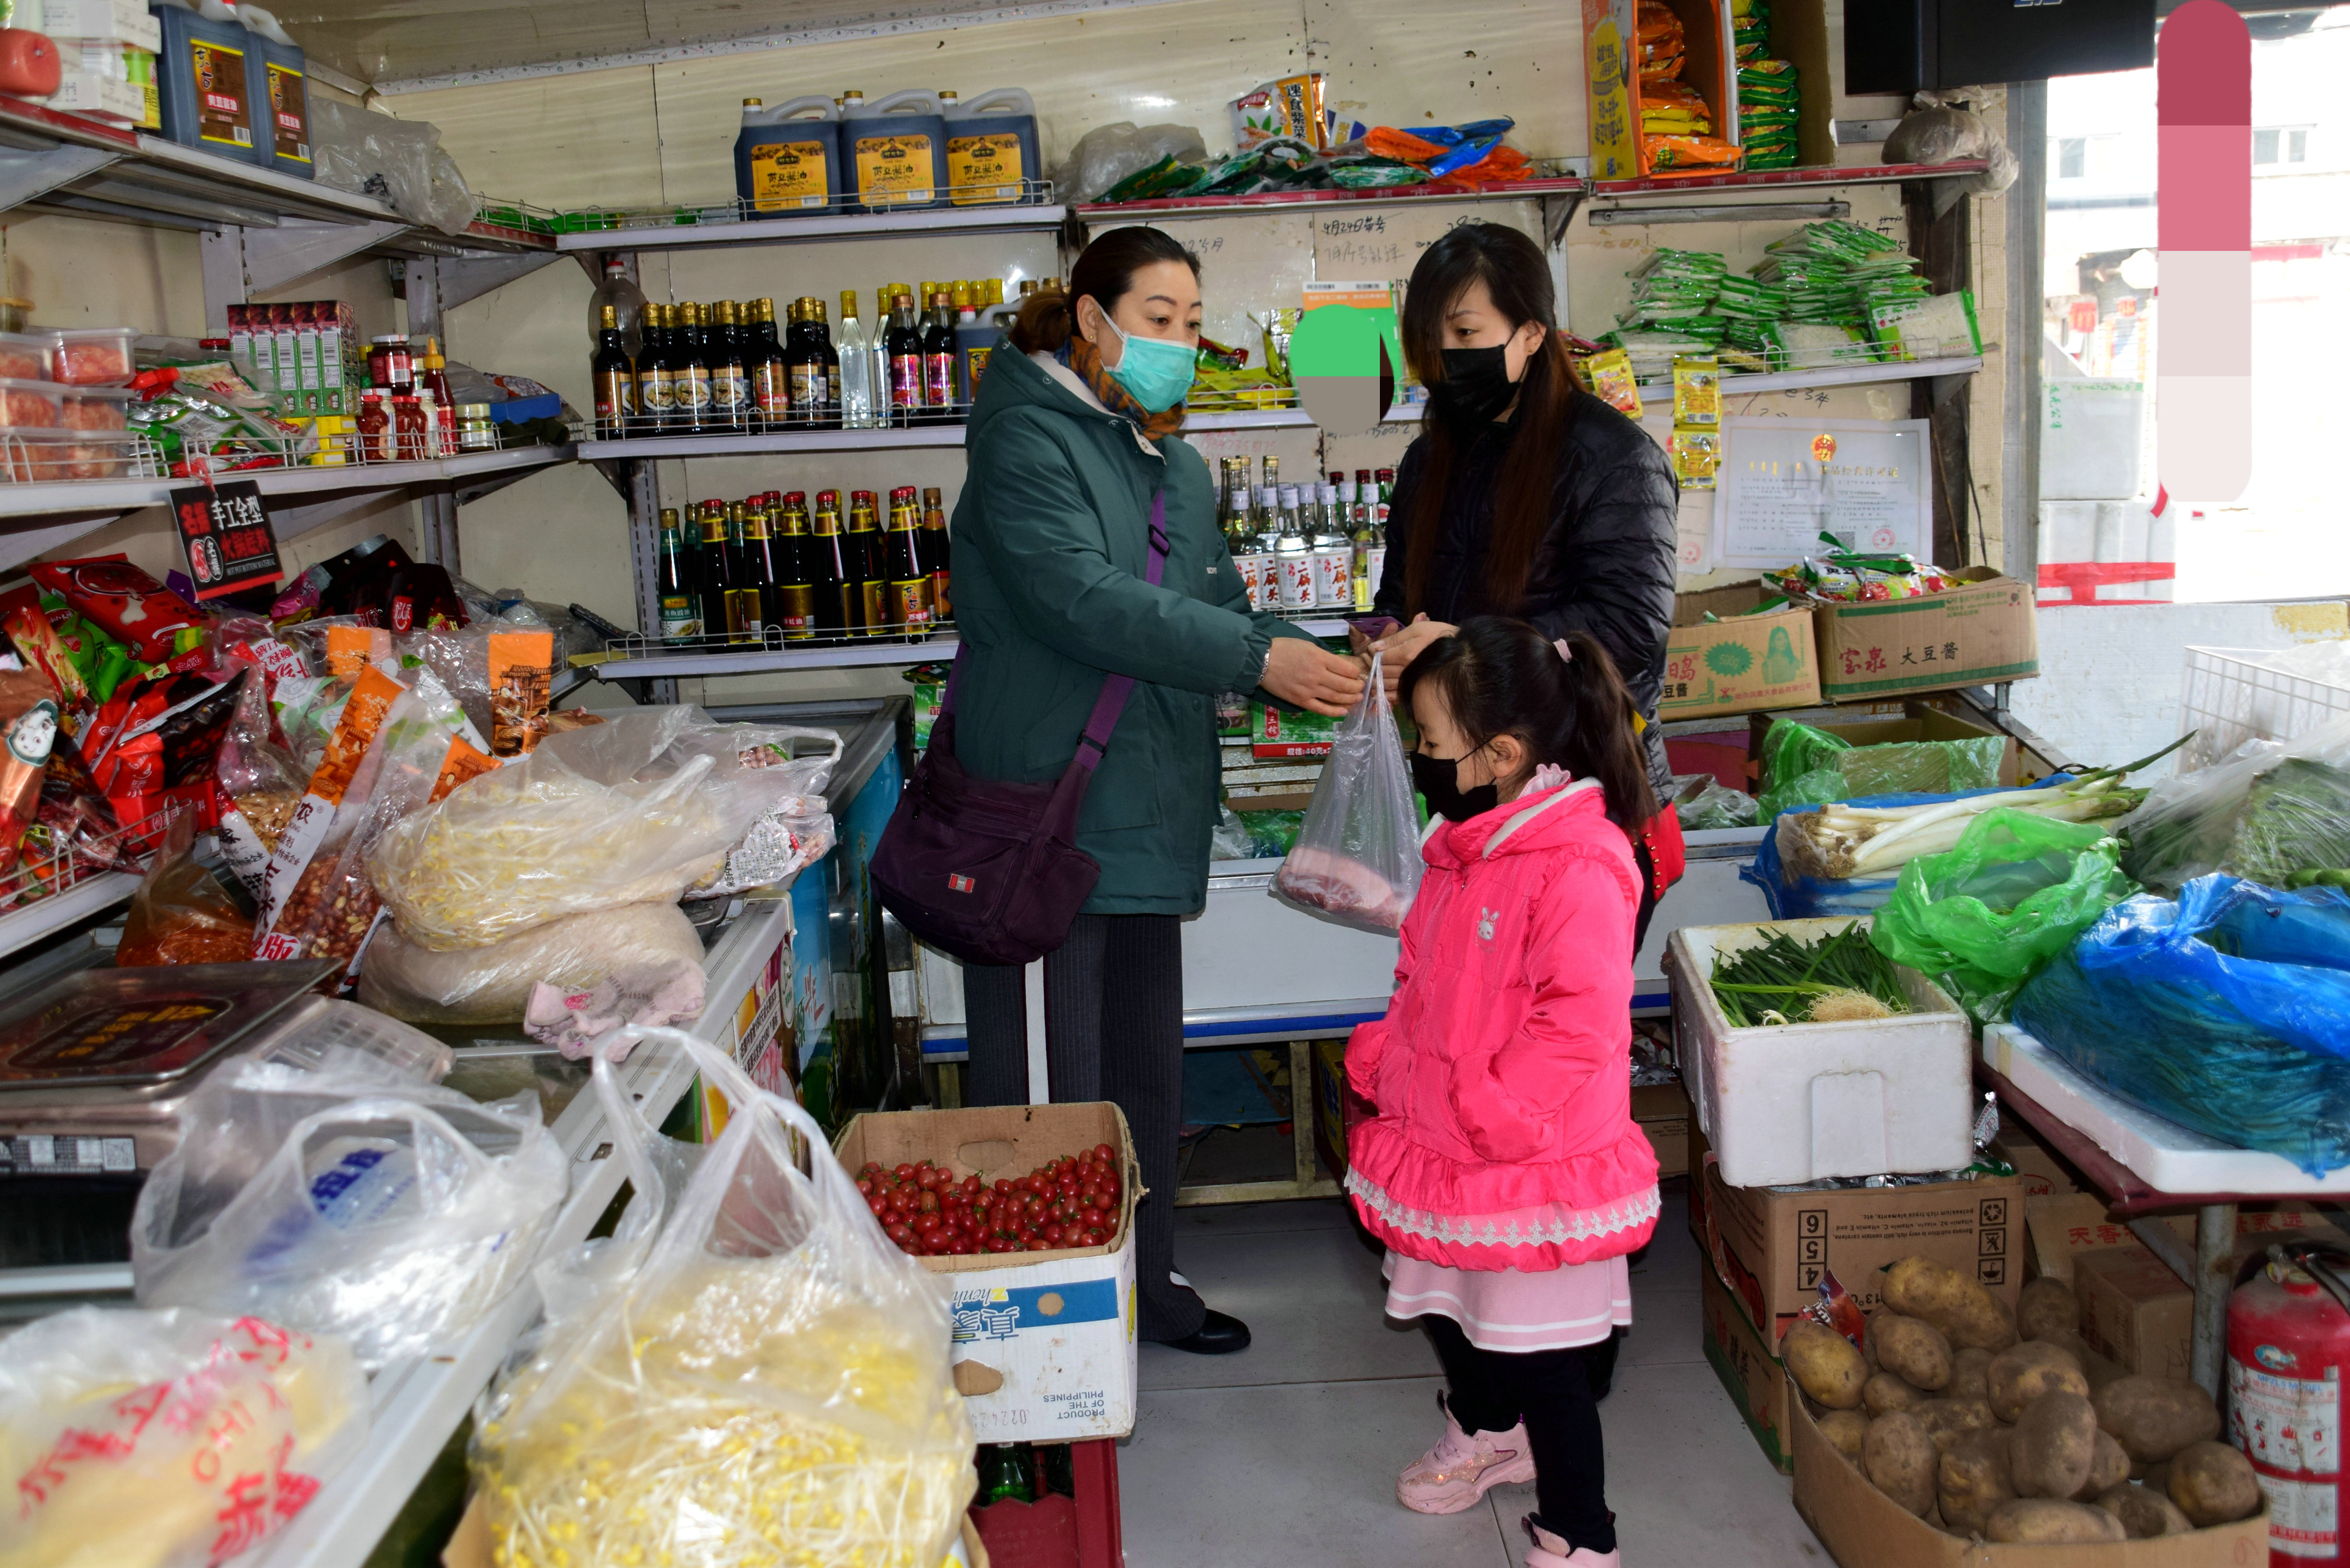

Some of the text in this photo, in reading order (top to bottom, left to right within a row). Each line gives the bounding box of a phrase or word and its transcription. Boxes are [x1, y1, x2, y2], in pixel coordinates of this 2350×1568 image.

[1285, 83, 1306, 139] 速食紫菜
[211, 495, 264, 531] 手工全型
[221, 527, 271, 562] 火锅底料
[1263, 560, 1278, 602] 二锅头
[1296, 561, 1311, 603] 二锅头
[1332, 557, 1347, 599] 二锅头
[903, 585, 918, 610] 东古
[395, 602, 412, 620] 好人家
[255, 639, 279, 658] 口感
[267, 645, 294, 665] 颗粒
[1838, 641, 1959, 675] 宝泉 大豆酱
[1663, 682, 1688, 699] 豆酱
[1940, 1208, 1974, 1216] potassium
[1806, 1241, 1819, 1259] 5
[1806, 1267, 1819, 1285] 4
[2289, 1381, 2323, 1391] MODEL
[1043, 1390, 1104, 1402] PHILIPPINES
[1068, 1401, 1088, 1409] THE
[1057, 1409, 1105, 1420] PRODUCT
